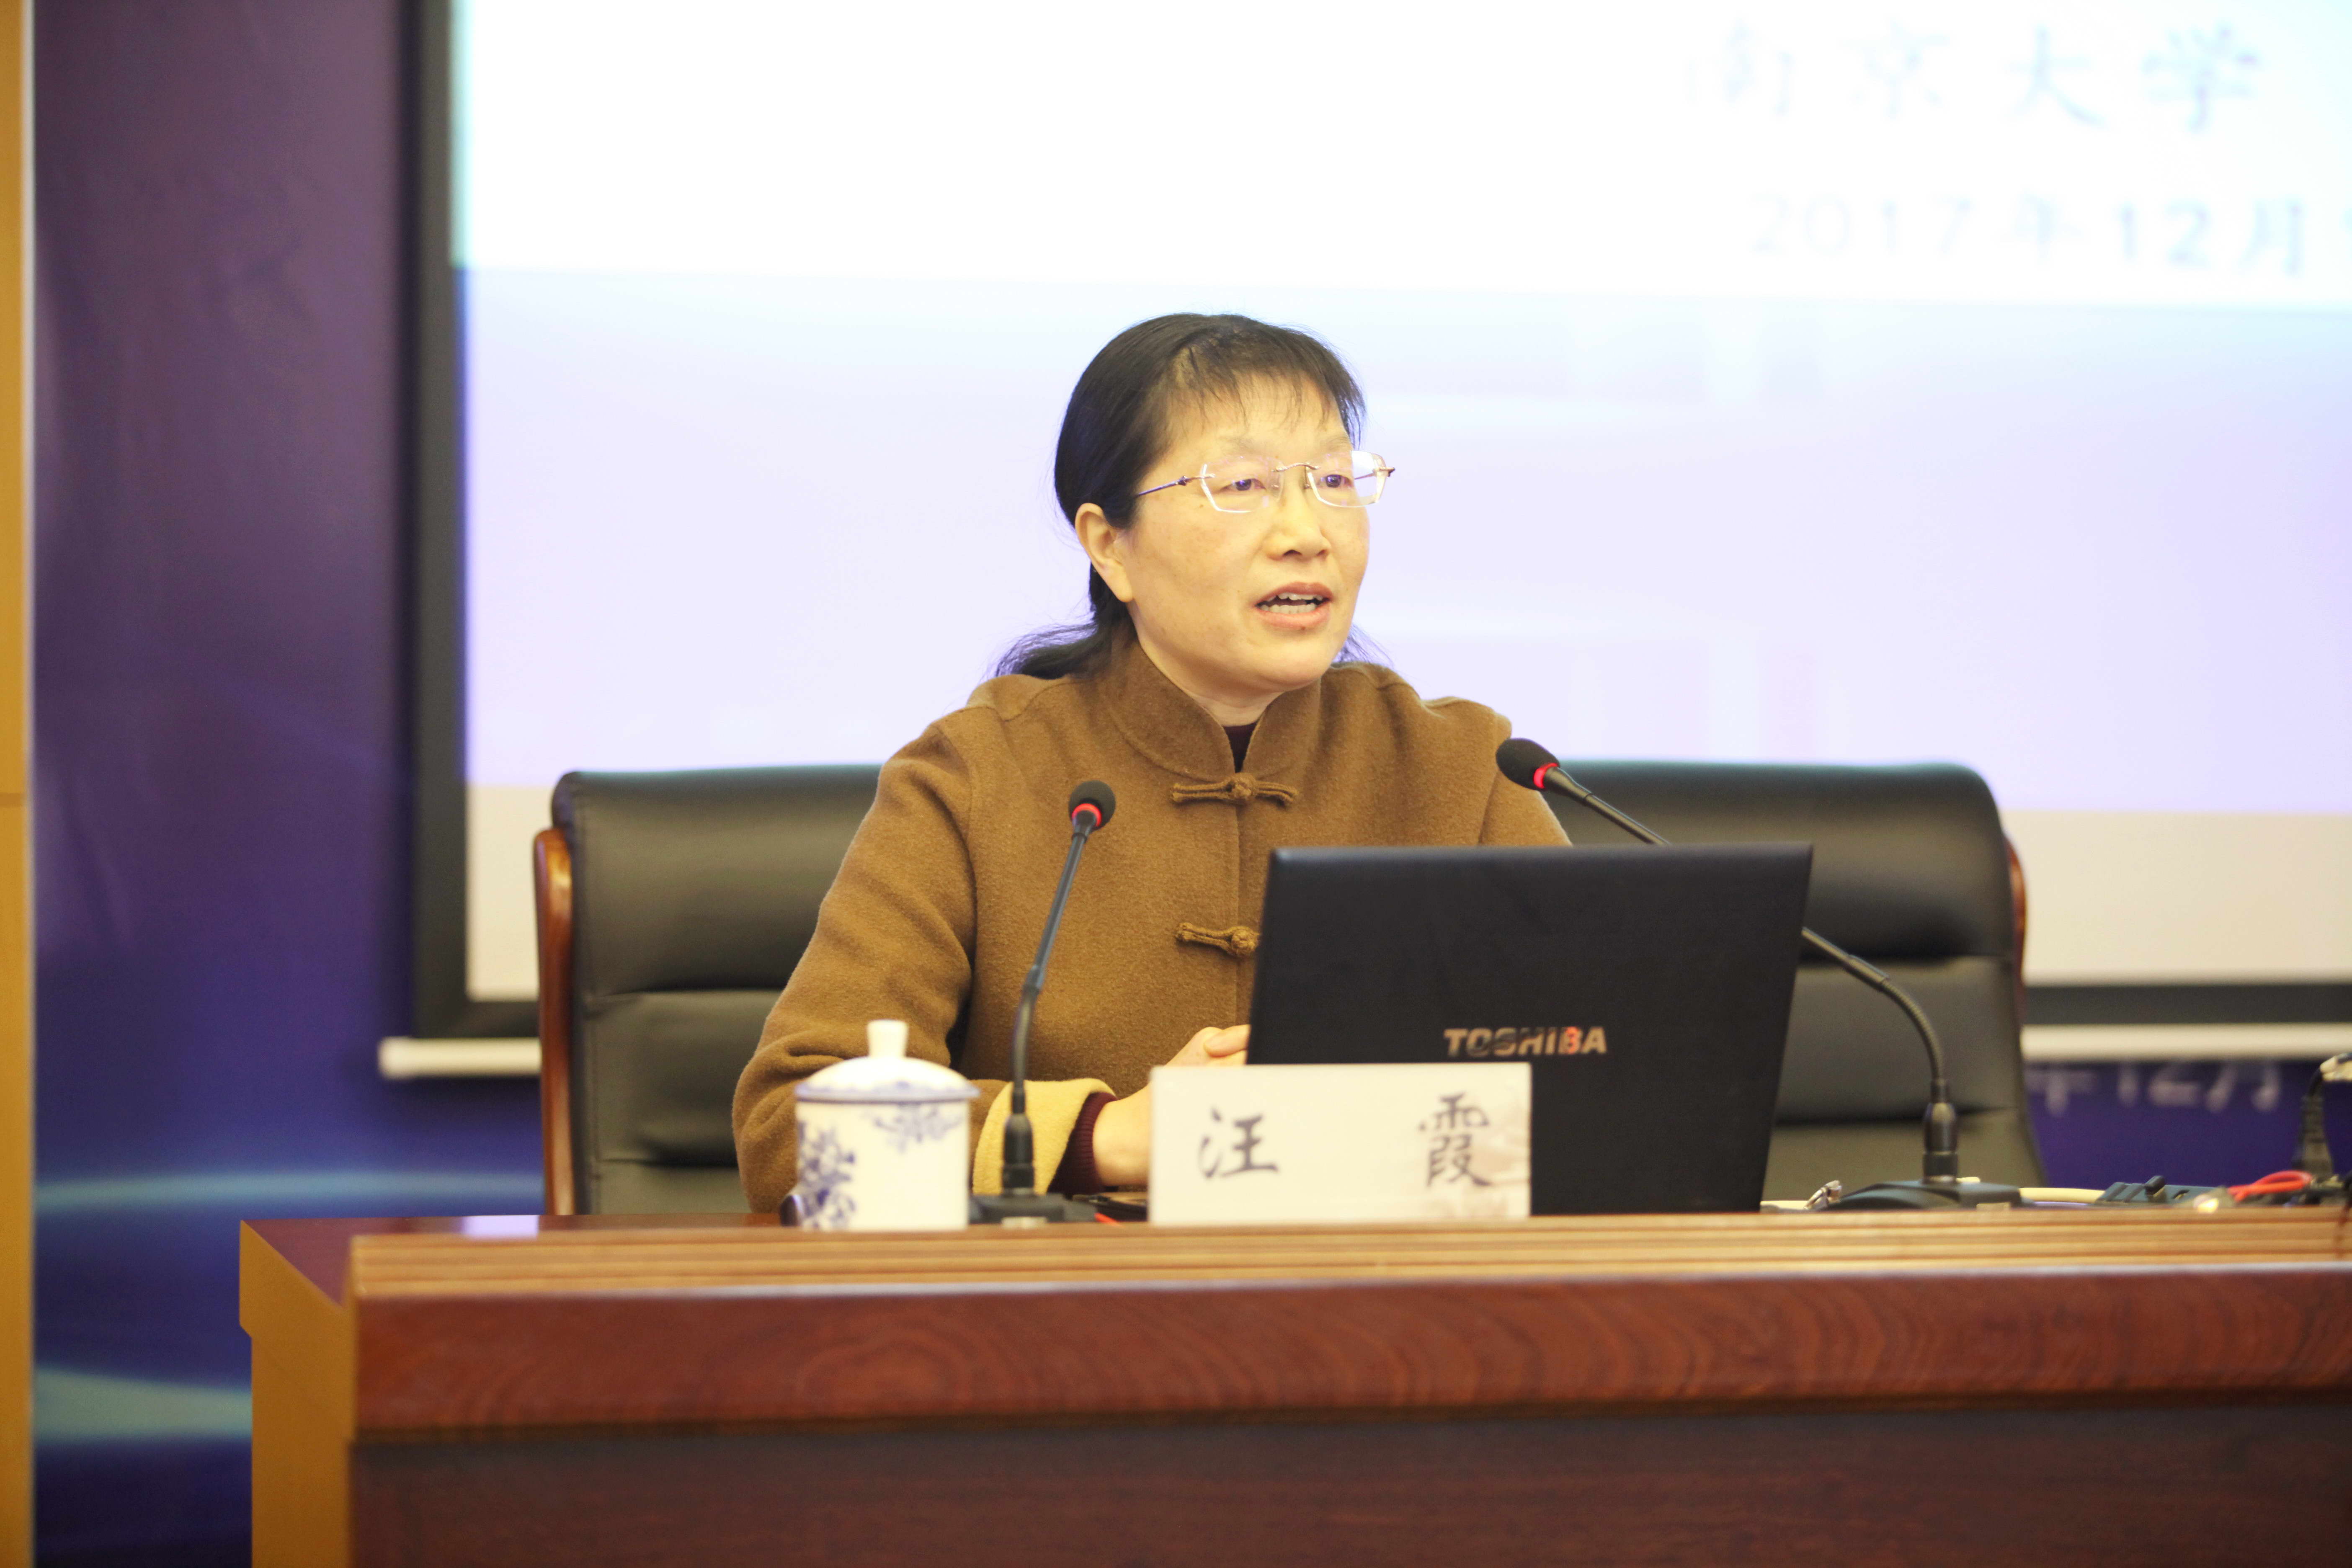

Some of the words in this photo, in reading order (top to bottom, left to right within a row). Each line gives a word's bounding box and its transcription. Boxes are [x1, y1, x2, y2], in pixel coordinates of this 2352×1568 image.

[1444, 1026, 1607, 1057] TOSHIBA
[1198, 1106, 1279, 1181] 汪
[1418, 1092, 1492, 1188] 霞
